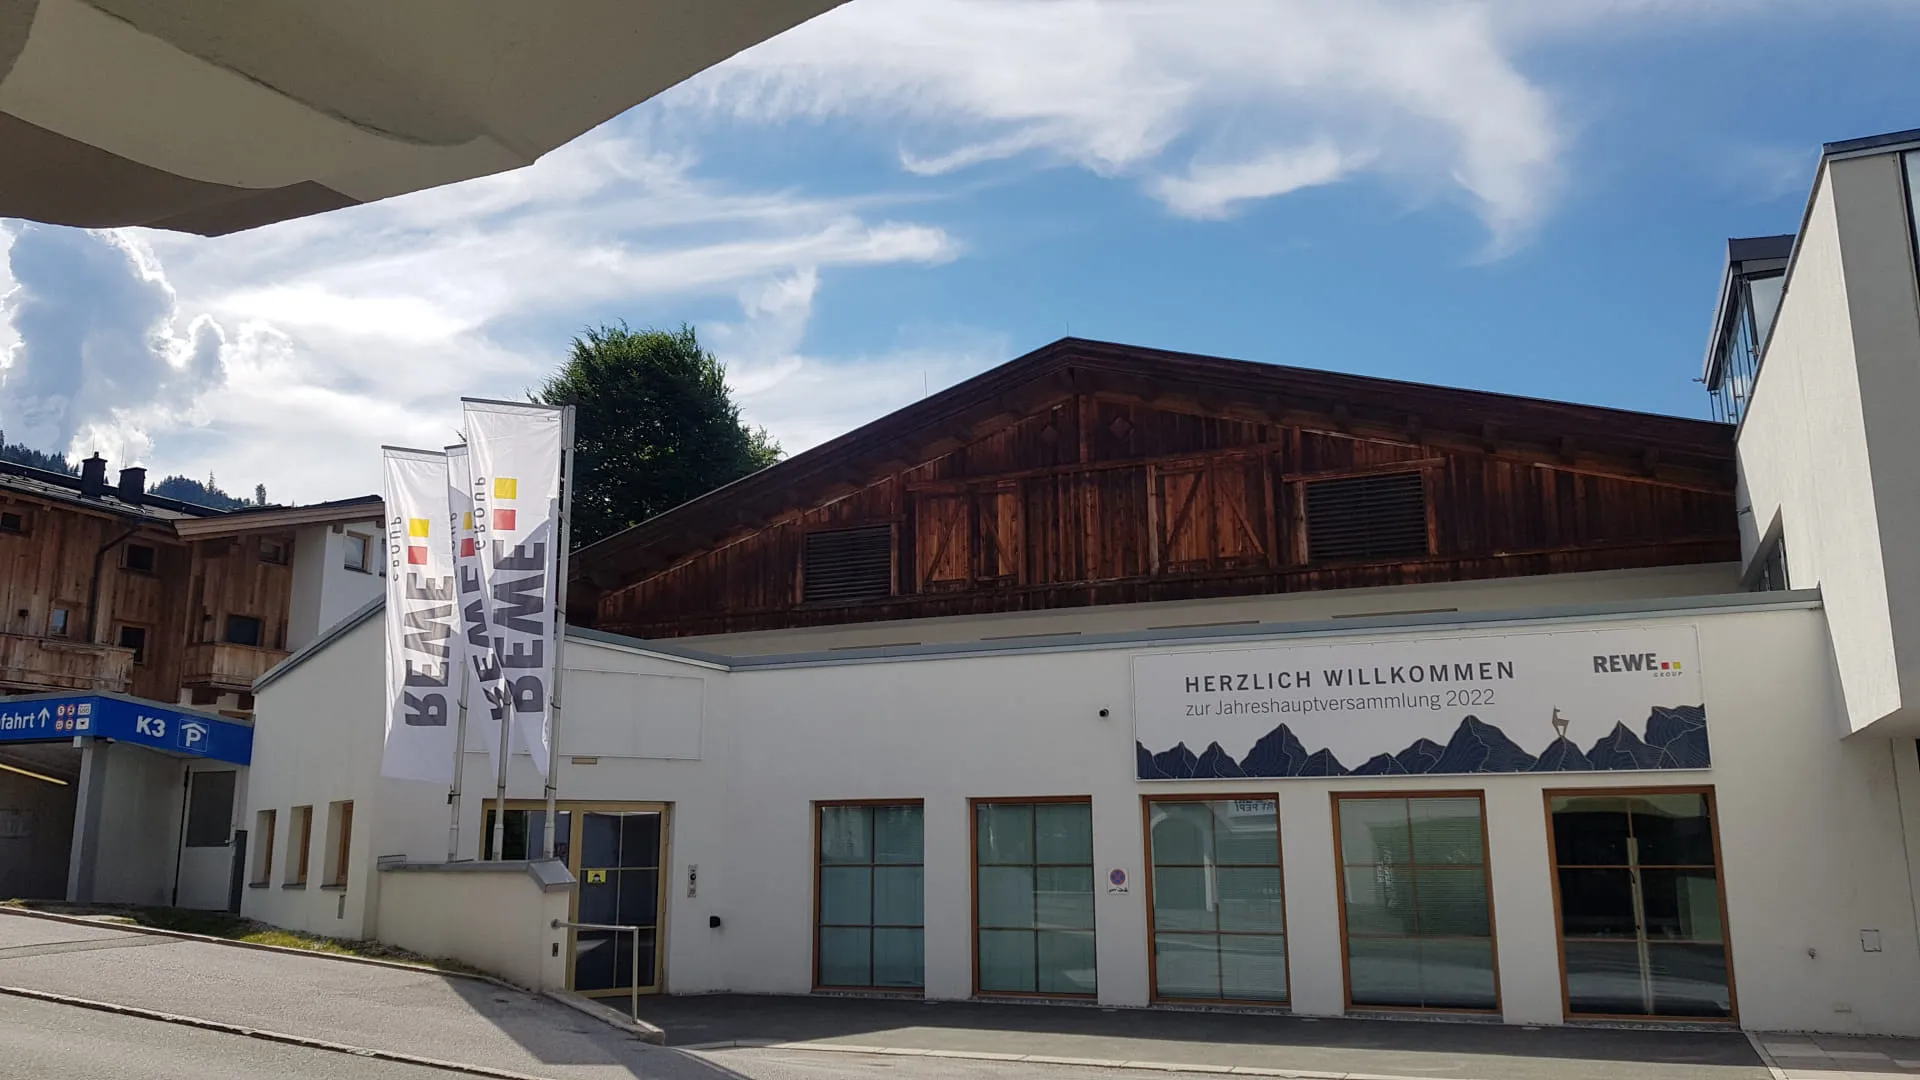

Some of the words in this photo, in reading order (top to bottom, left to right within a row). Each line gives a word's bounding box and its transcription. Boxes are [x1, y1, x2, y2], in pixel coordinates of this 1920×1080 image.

[1593, 653, 1658, 673] REWE
[1185, 671, 1311, 693] HERZLICH
[1323, 661, 1514, 687] WILLKOMMEN
[1186, 703, 1211, 717] zur
[1215, 692, 1441, 716] Jahreshauptversammlung
[1446, 688, 1495, 707] 2022
[0, 712, 35, 730] fahrt
[136, 715, 166, 738] K3
